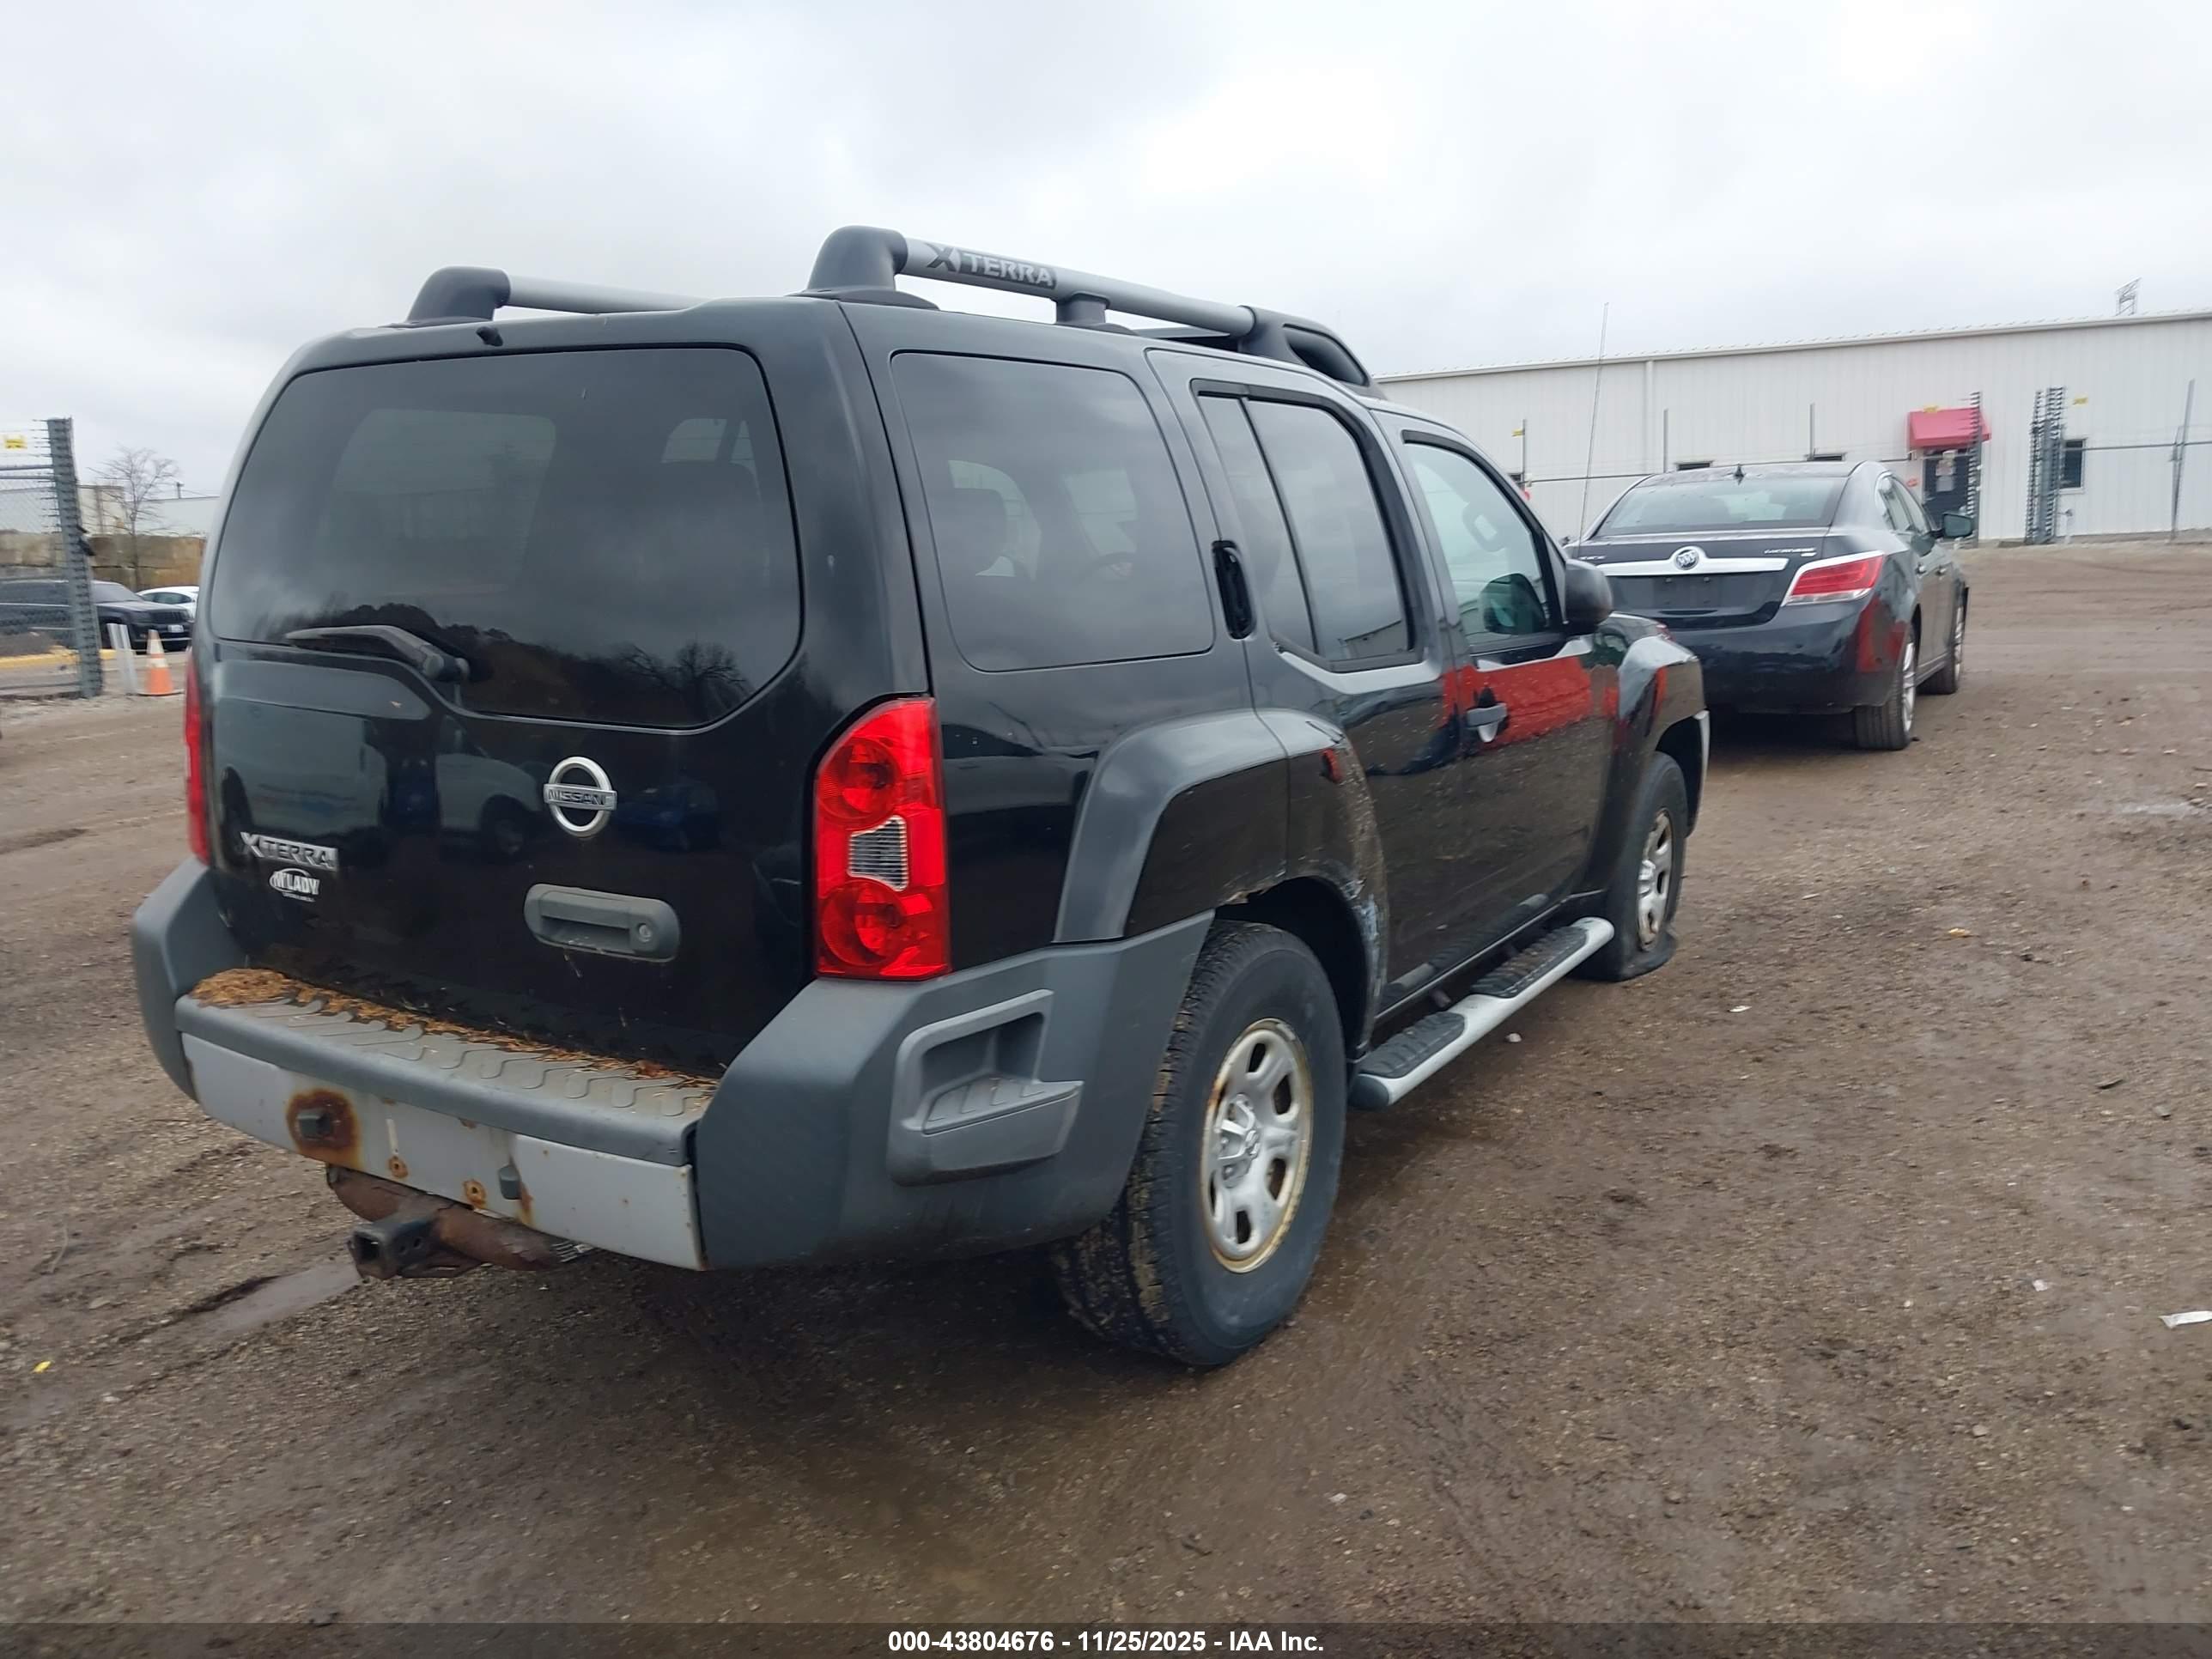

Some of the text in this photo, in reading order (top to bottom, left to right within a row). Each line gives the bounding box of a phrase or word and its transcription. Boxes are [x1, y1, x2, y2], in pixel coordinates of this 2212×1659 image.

[924, 242, 1056, 289] XTERRA
[549, 788, 606, 805] NISSAN
[240, 831, 338, 872] XTERRA
